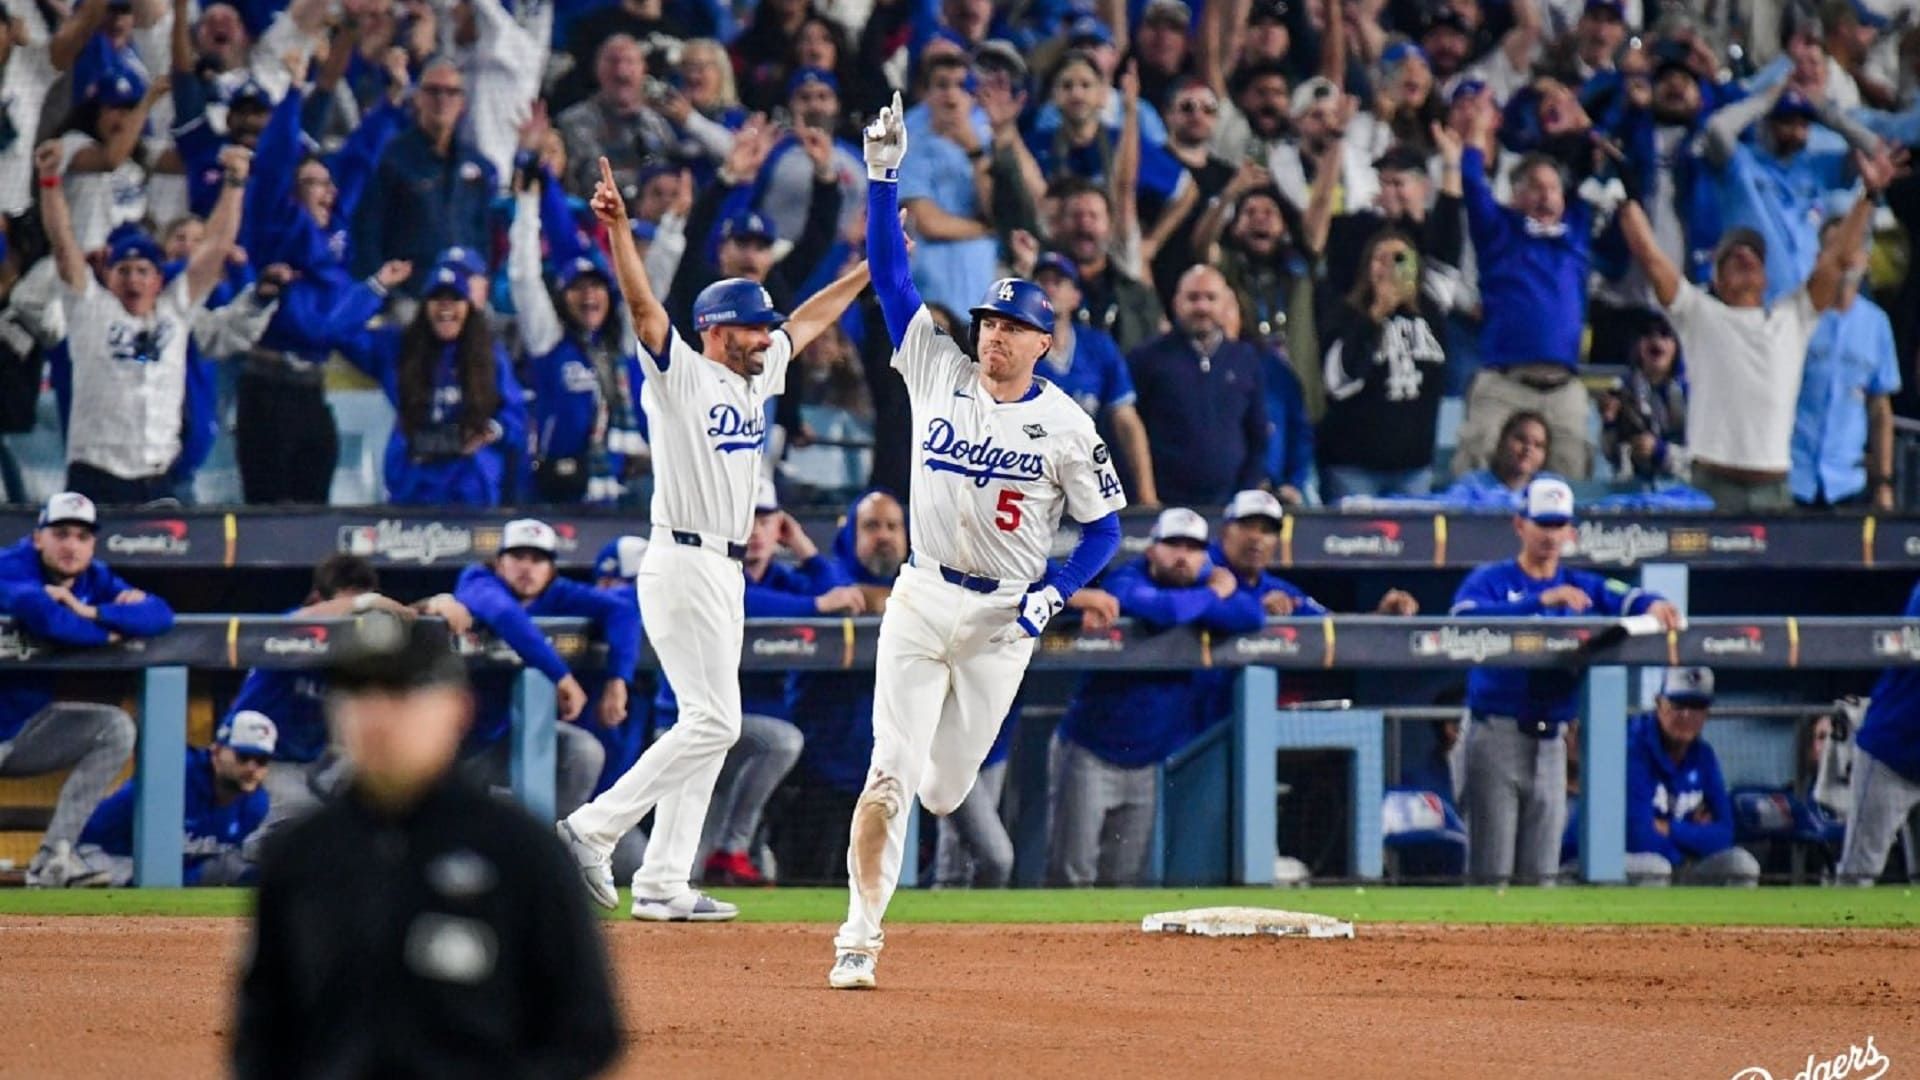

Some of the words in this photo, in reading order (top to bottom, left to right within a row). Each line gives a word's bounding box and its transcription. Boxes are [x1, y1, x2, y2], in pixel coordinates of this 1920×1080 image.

[922, 417, 1044, 488] Dodgers
[1094, 469, 1121, 499] LA
[995, 489, 1025, 531] 5
